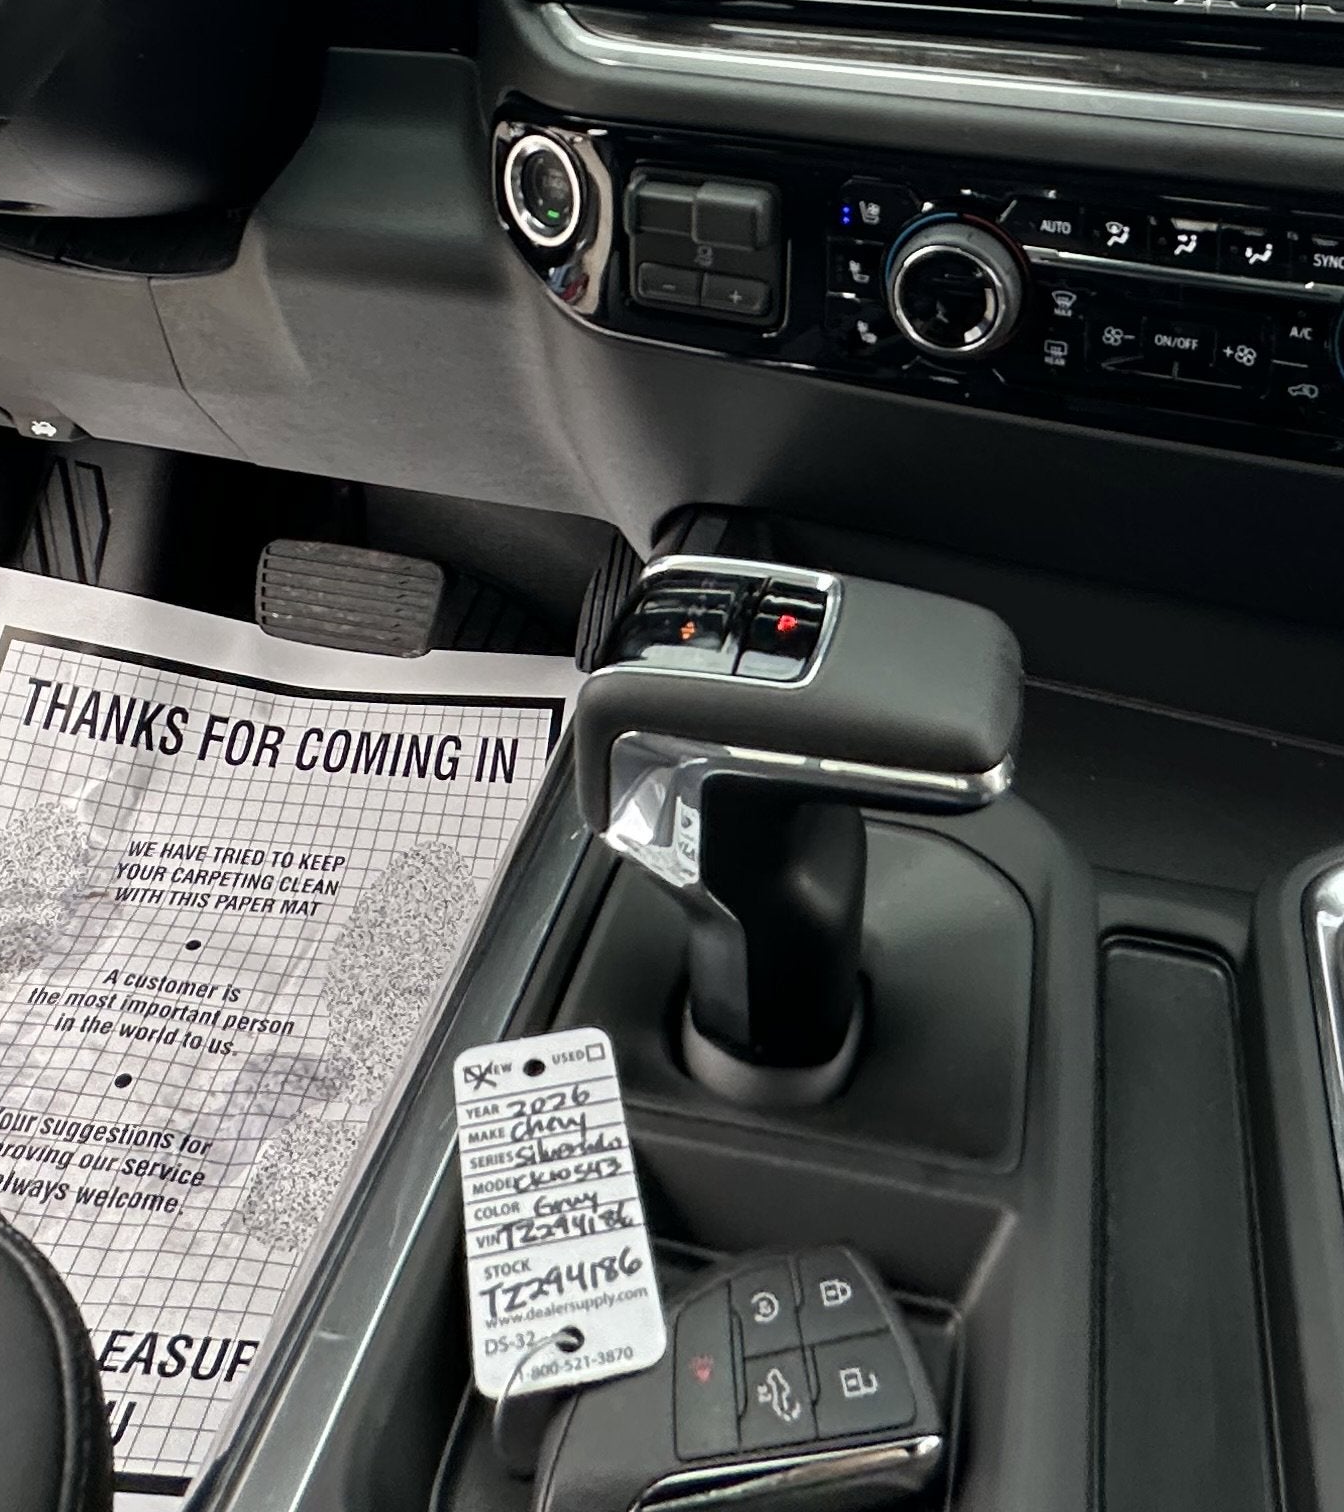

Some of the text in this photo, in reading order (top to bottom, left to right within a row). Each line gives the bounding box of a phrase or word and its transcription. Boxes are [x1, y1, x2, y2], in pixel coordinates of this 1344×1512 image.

[1040, 219, 1071, 235] AUTO
[1154, 334, 1199, 351] ON/OFF
[1289, 326, 1313, 341] A/C
[22, 677, 520, 785] THANKS FOR COMING IN
[127, 840, 346, 873] WE HAVE TRIED TO KEEP
[116, 862, 340, 896] YOUR CARPETING CLEAN
[114, 887, 322, 917] WITH THIS PAPER MAT
[102, 968, 241, 1003] A customer is
[27, 987, 296, 1037] the most important person
[53, 1013, 238, 1057] in the world to us.
[552, 1050, 585, 1064] USED
[466, 1103, 500, 1119] YEAR
[506, 1084, 590, 1118] 2026
[39, 1116, 175, 1150] suggestions
[179, 1133, 213, 1156] for
[468, 1127, 505, 1143] MAKE
[77, 1153, 119, 1172] our
[121, 1156, 206, 1187] service
[470, 1151, 514, 1169] SERIES
[474, 1201, 521, 1221] COLOR
[484, 1258, 531, 1281] STOCK
[485, 1287, 649, 1329] www.dealersupply.com
[484, 1330, 536, 1357] DS-32
